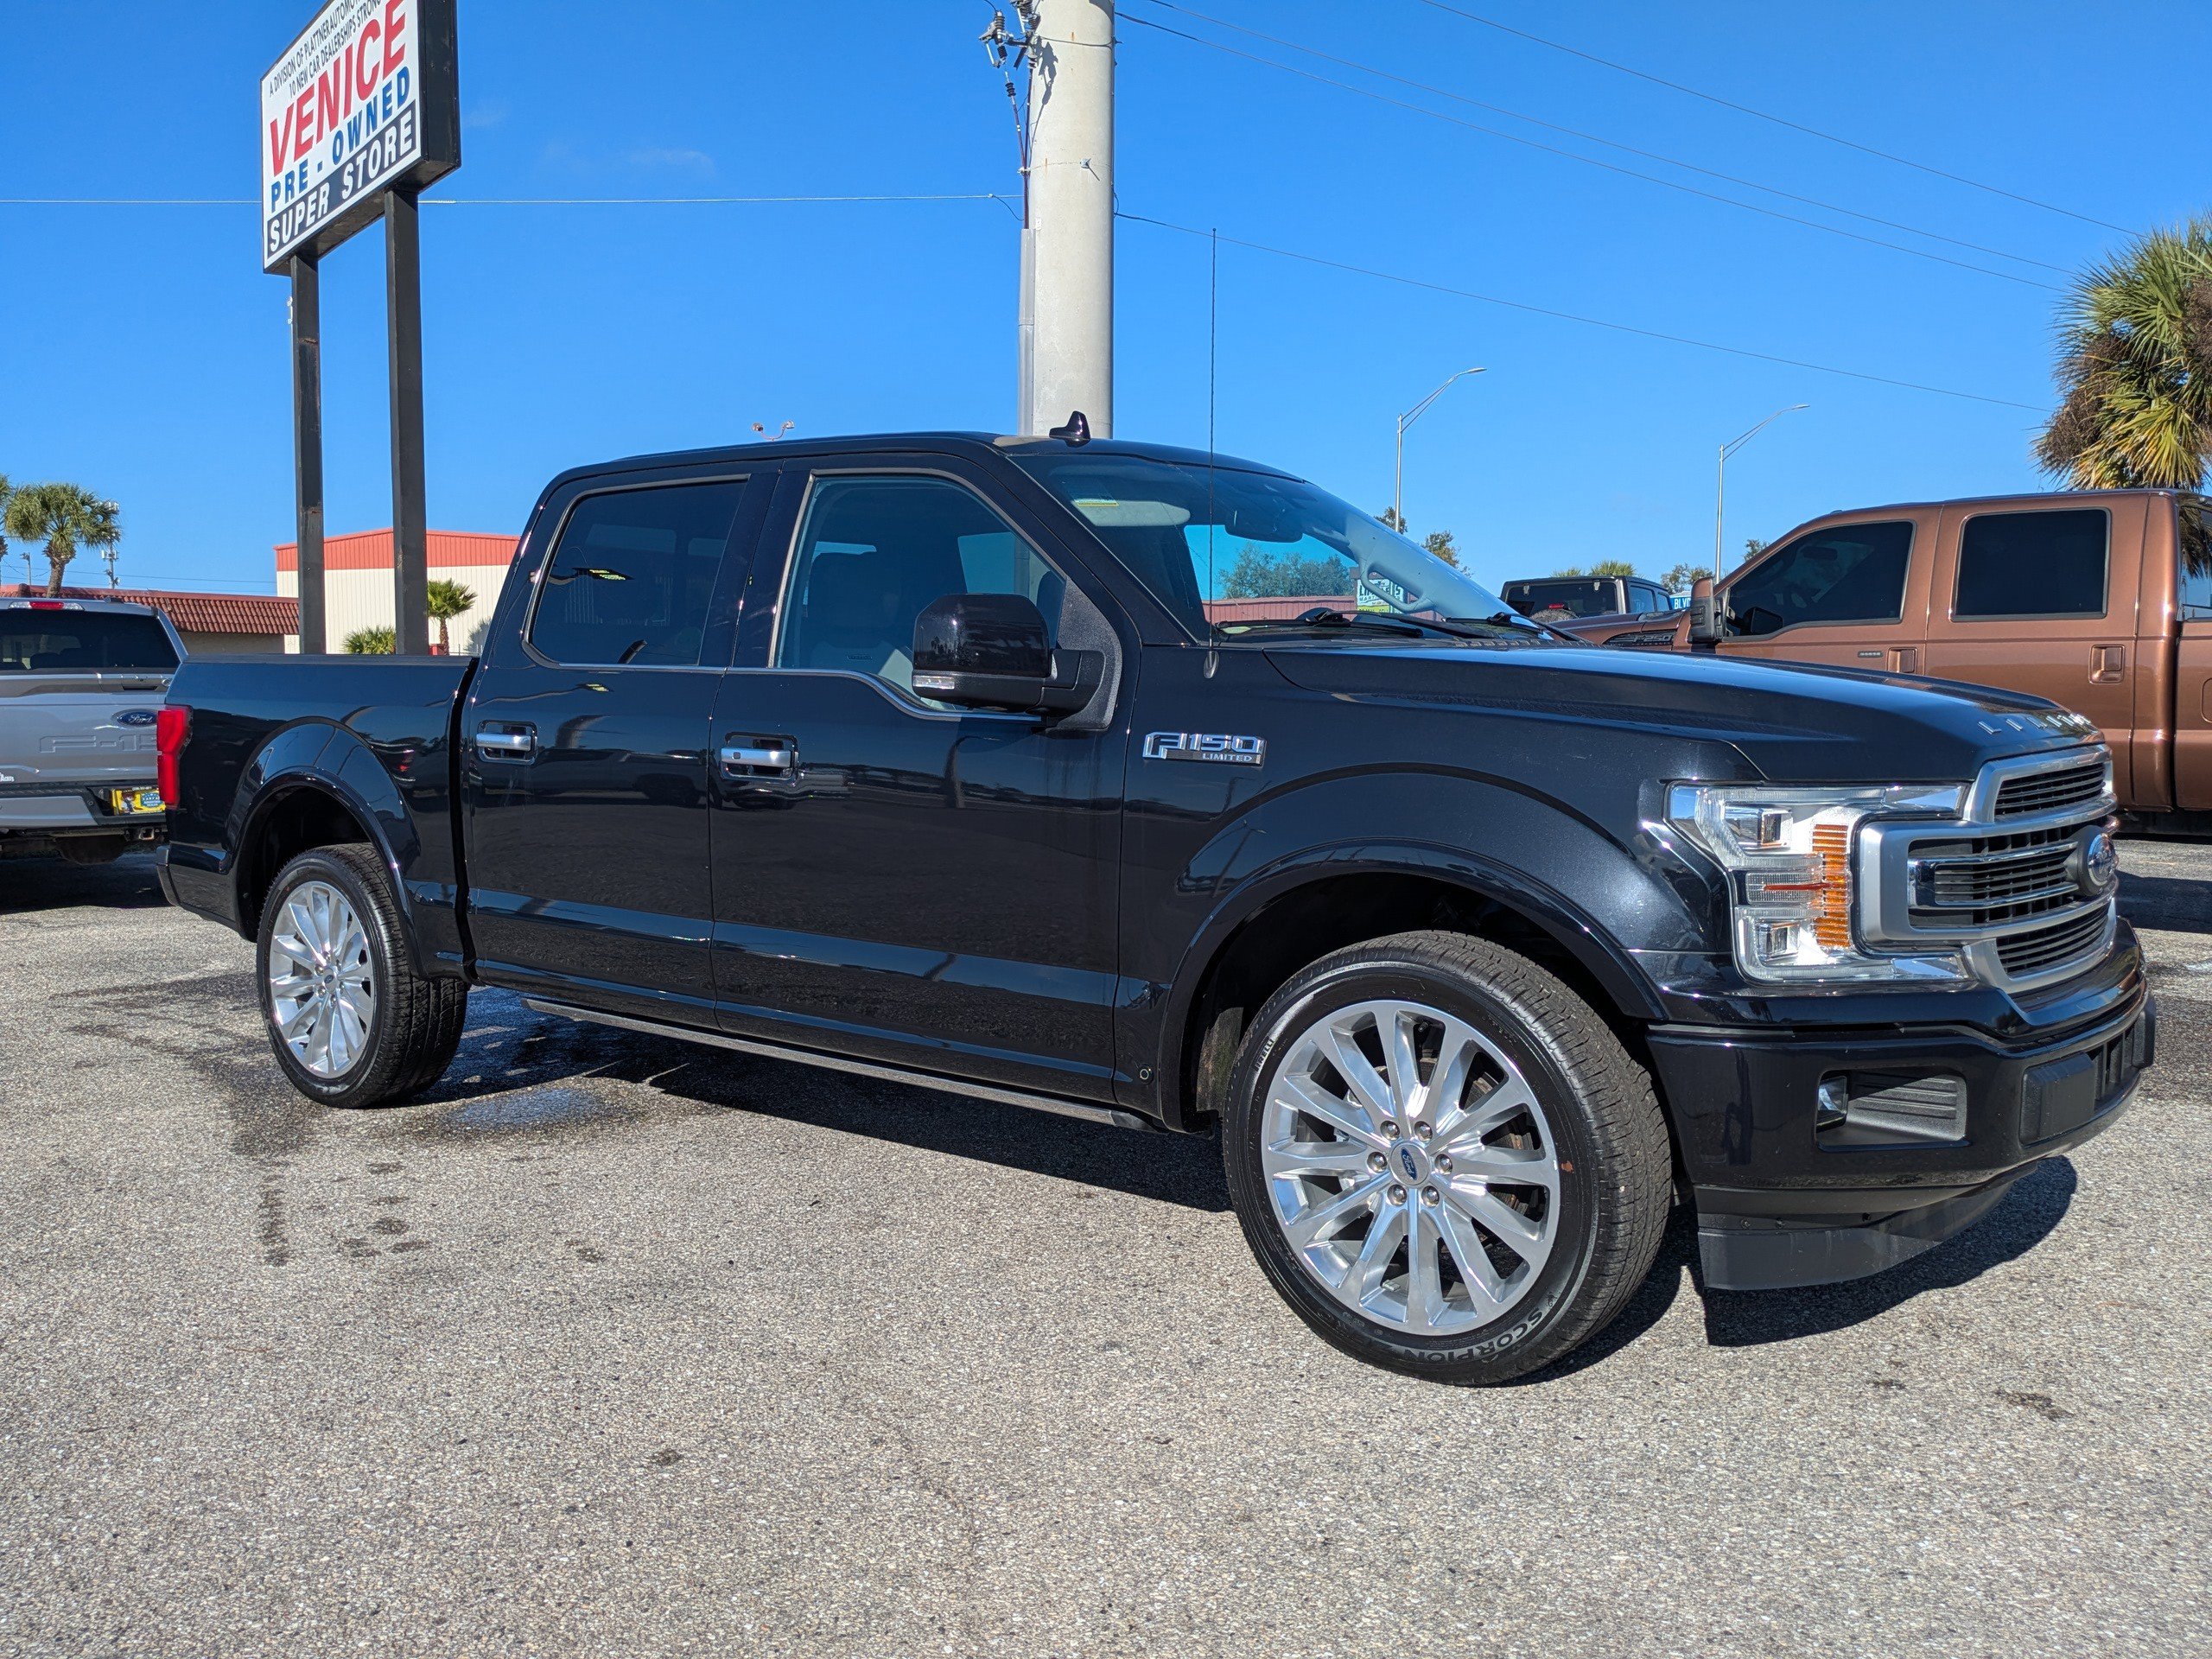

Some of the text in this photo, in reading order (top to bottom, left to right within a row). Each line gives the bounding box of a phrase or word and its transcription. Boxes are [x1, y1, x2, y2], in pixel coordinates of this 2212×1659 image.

[270, 81, 274, 98] A
[274, 56, 296, 92] DIVISION
[296, 47, 304, 68] OF
[304, 19, 331, 60] PLATTNER
[270, 0, 406, 178] VENICE
[296, 68, 308, 92] NEW
[309, 54, 321, 79] CAR
[321, 15, 356, 67] DEALERSHIPS
[270, 110, 413, 252] SUPER STORE
[128, 713, 154, 724] Ford
[1202, 753, 1253, 762] LIMITED
[1403, 1306, 1543, 1363] SCORPION
